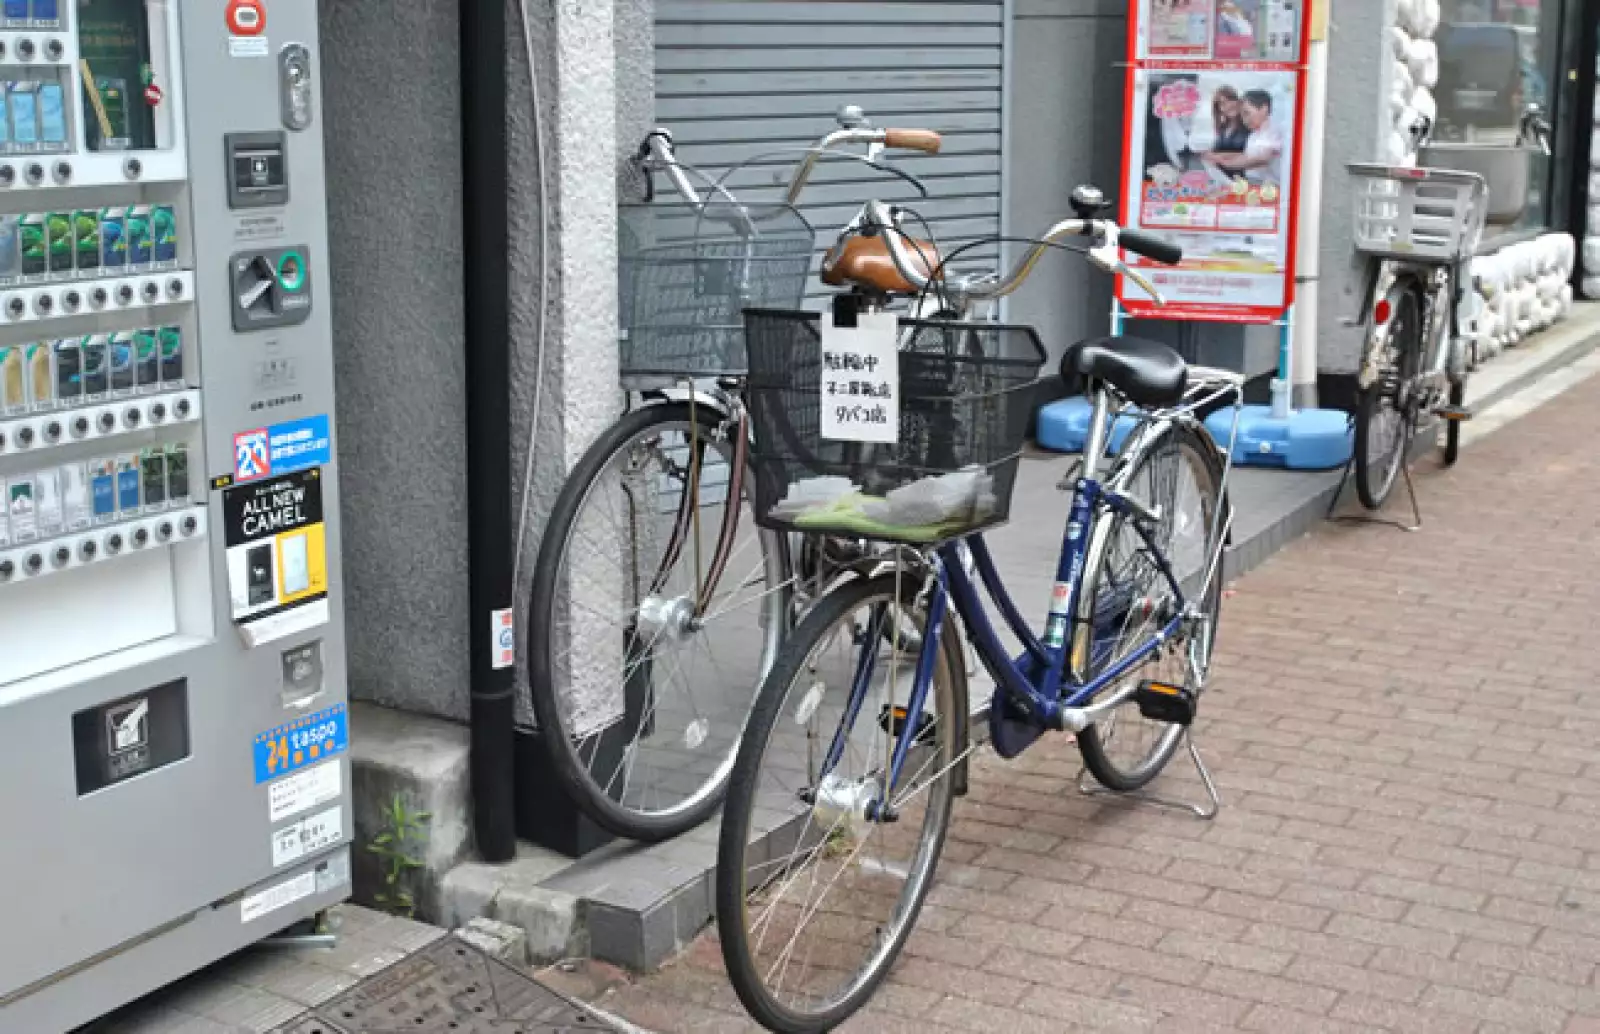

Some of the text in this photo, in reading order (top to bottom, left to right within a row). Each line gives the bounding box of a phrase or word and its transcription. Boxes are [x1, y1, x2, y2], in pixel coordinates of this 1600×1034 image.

[824, 352, 879, 372] 駐輪中
[243, 497, 271, 516] ALL
[273, 486, 306, 508] NEW
[243, 505, 307, 536] CAMEL
[292, 720, 337, 749] taspo
